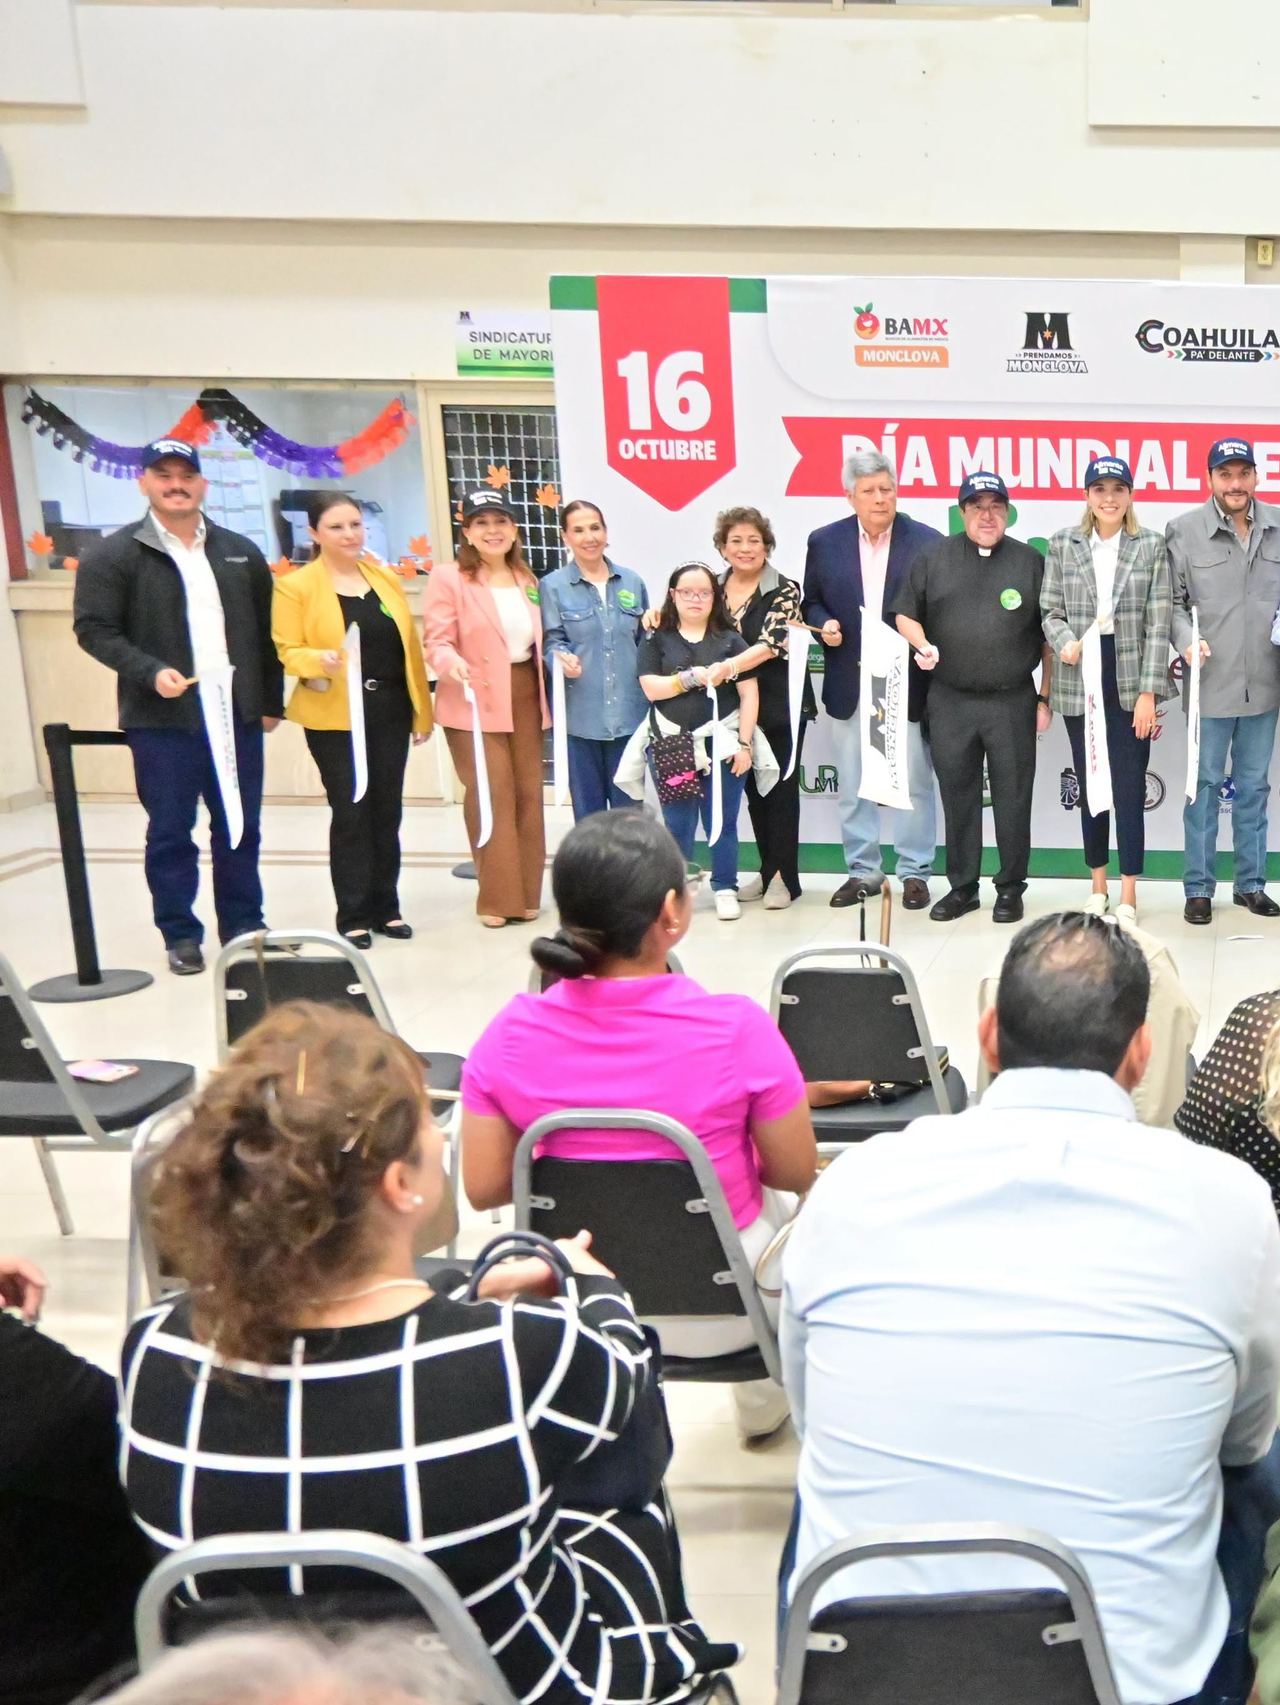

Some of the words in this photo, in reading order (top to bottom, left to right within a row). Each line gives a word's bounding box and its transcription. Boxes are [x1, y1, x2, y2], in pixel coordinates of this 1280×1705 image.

[885, 317, 949, 336] BAMX
[1020, 311, 1074, 350] M
[1135, 319, 1280, 353] COAHUILA
[473, 348, 492, 360] DE
[863, 349, 940, 363] MONCLOVA
[1209, 351, 1256, 361] DELANTE
[1006, 359, 1088, 374] MONCLOVA
[616, 350, 712, 432] 16
[618, 438, 717, 461] OCTUBRE
